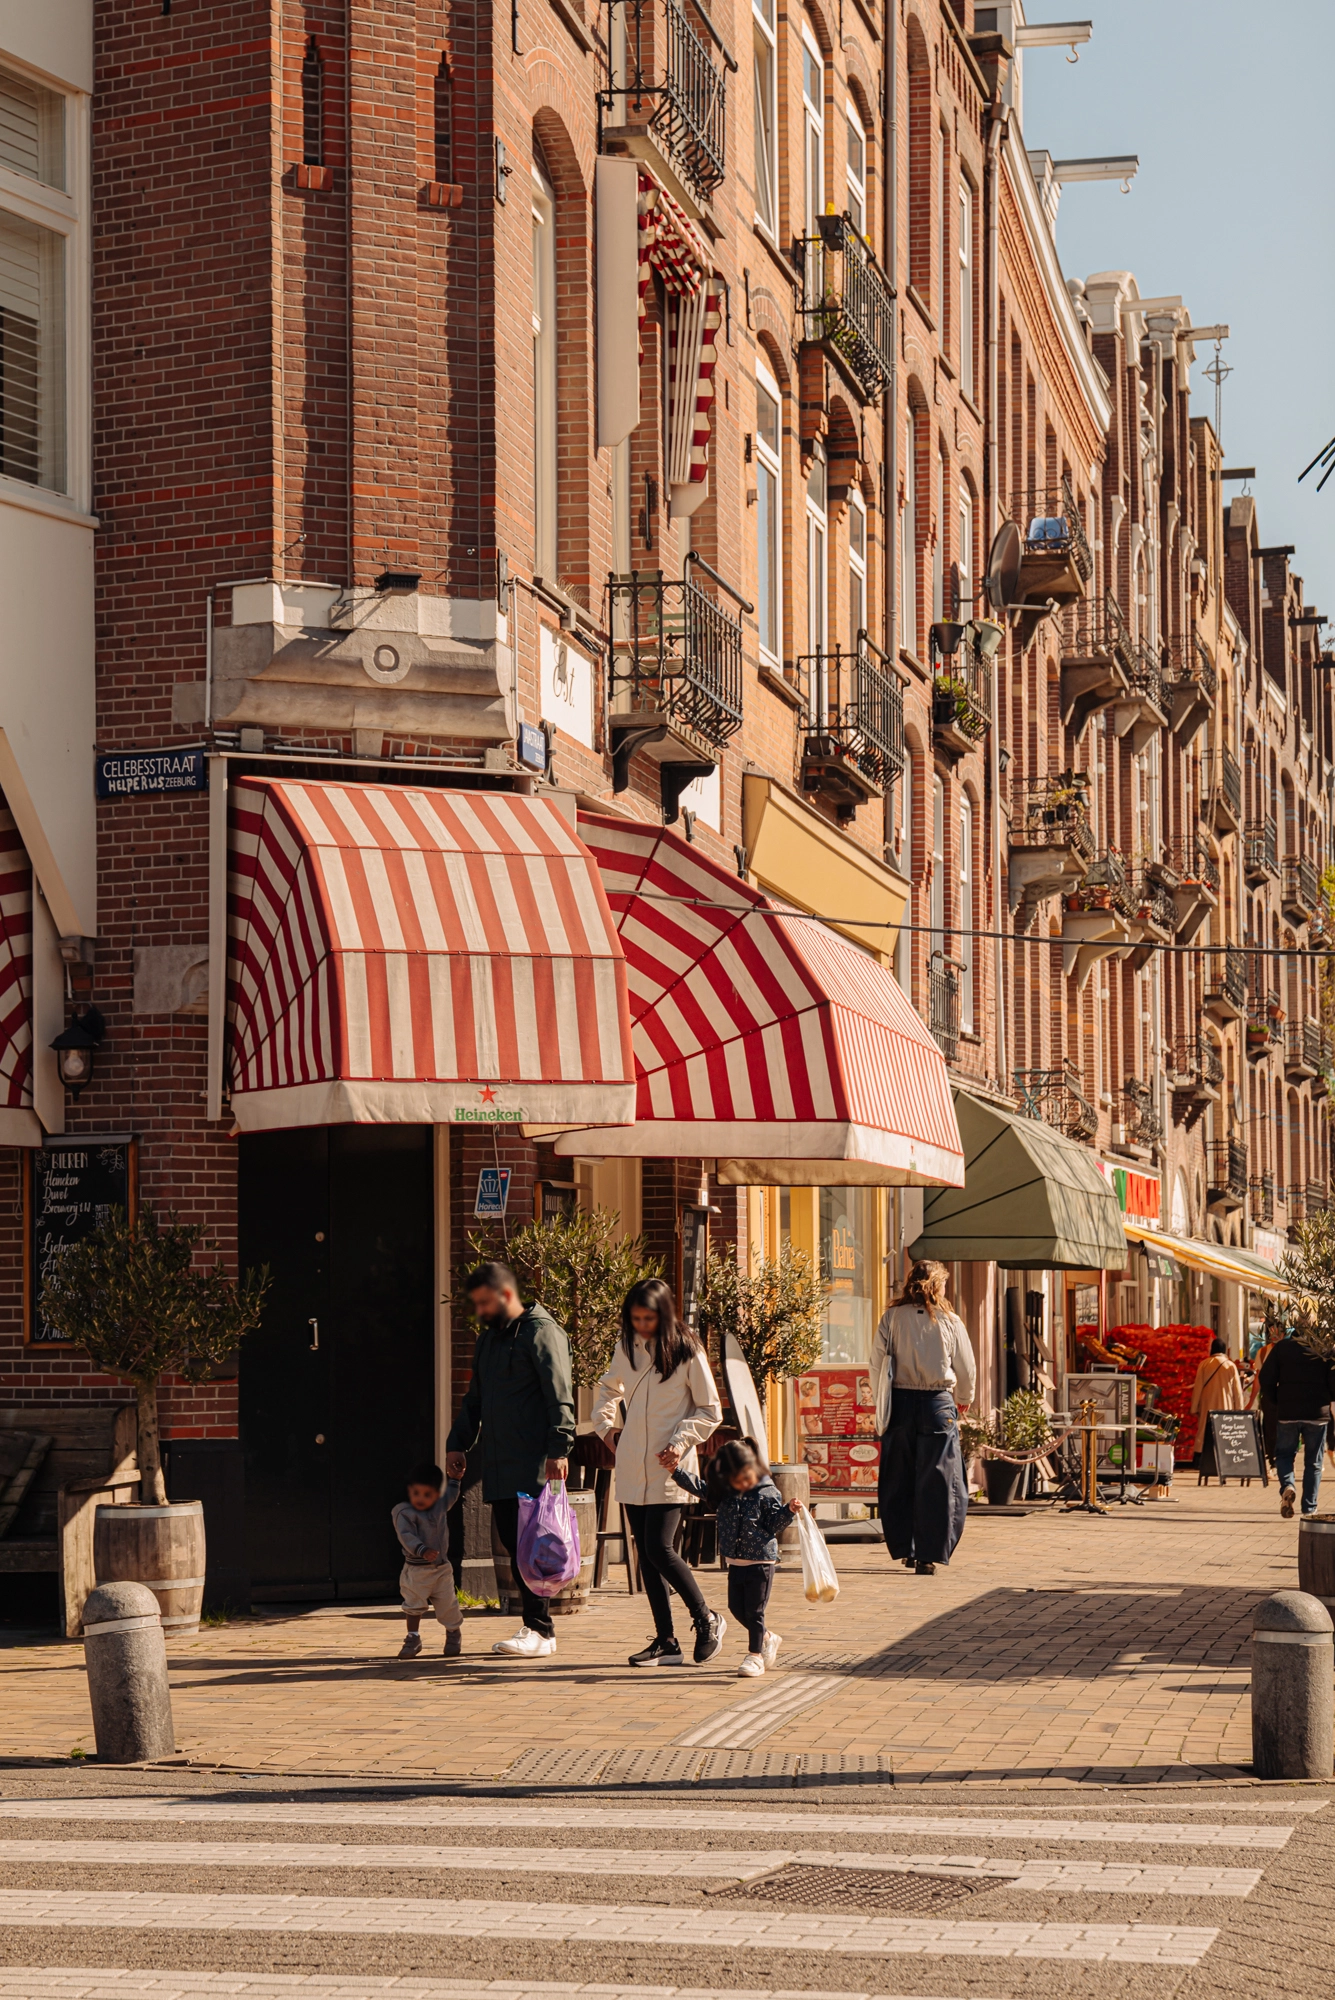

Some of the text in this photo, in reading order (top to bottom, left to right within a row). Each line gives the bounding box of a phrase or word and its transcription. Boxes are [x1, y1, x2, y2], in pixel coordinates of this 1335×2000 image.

[102, 755, 197, 778] CELEBESSTRAAT
[165, 775, 197, 788] ZEEBURG
[454, 1108, 523, 1121] Heineken
[51, 1152, 88, 1169] BIEREN
[43, 1169, 80, 1187] Heineken
[42, 1186, 69, 1200] Duvel
[832, 1226, 856, 1270] Bahia
